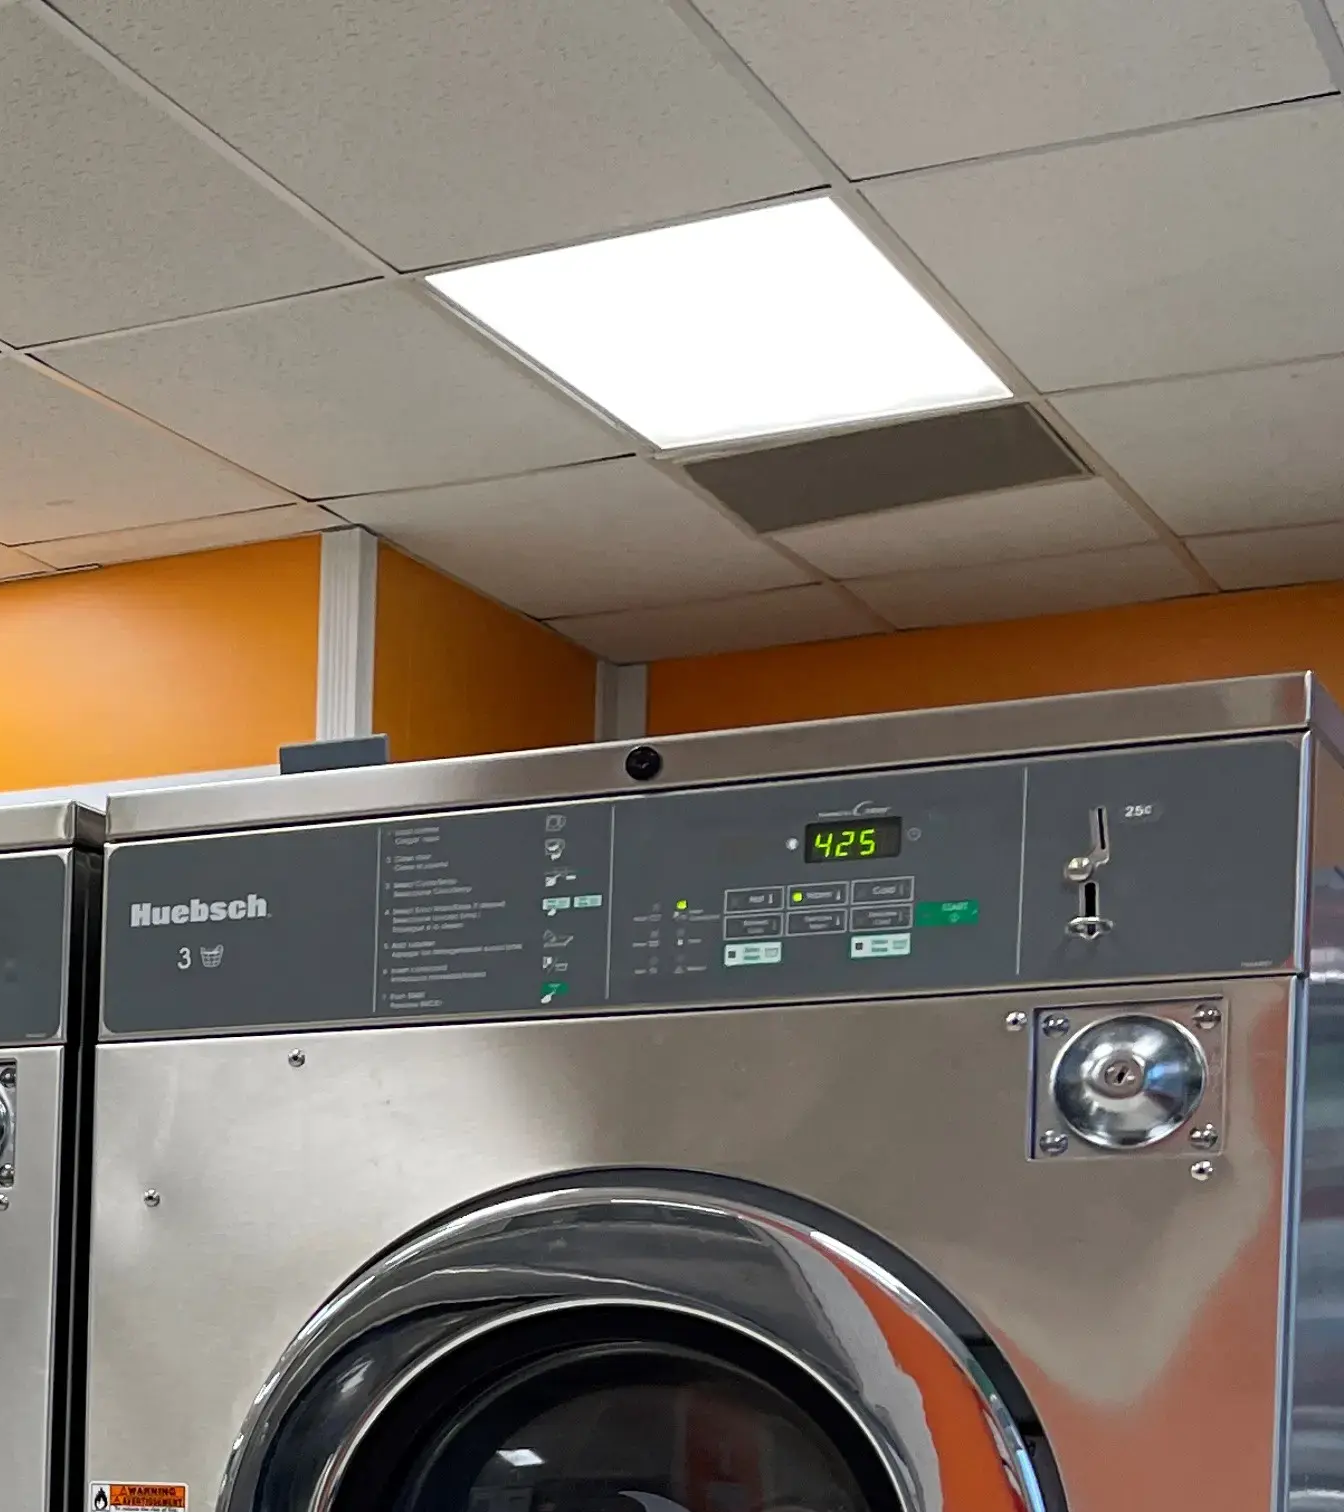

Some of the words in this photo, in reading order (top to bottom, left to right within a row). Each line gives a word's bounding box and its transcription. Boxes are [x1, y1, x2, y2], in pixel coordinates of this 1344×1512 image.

[814, 828, 875, 857] 425
[130, 893, 268, 927] Huebsch
[177, 947, 192, 969] 3
